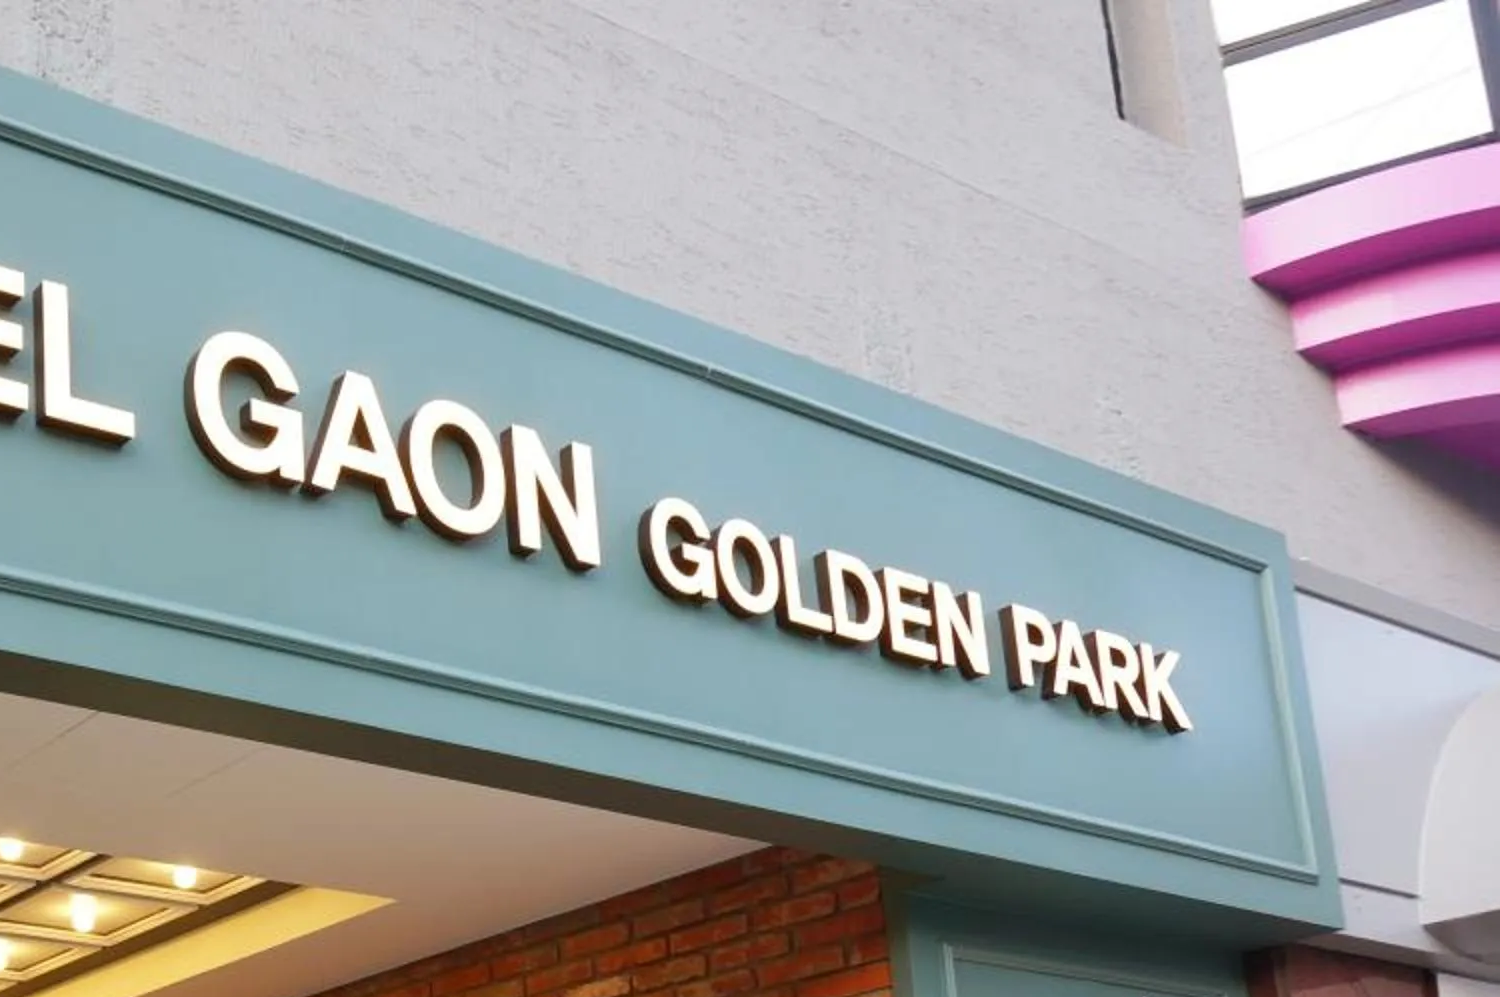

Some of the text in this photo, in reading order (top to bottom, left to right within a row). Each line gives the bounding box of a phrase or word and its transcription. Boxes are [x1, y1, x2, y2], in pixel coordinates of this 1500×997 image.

[185, 331, 601, 571] GAON
[639, 497, 990, 679] GOLDEN
[1000, 603, 1193, 733] PARK
